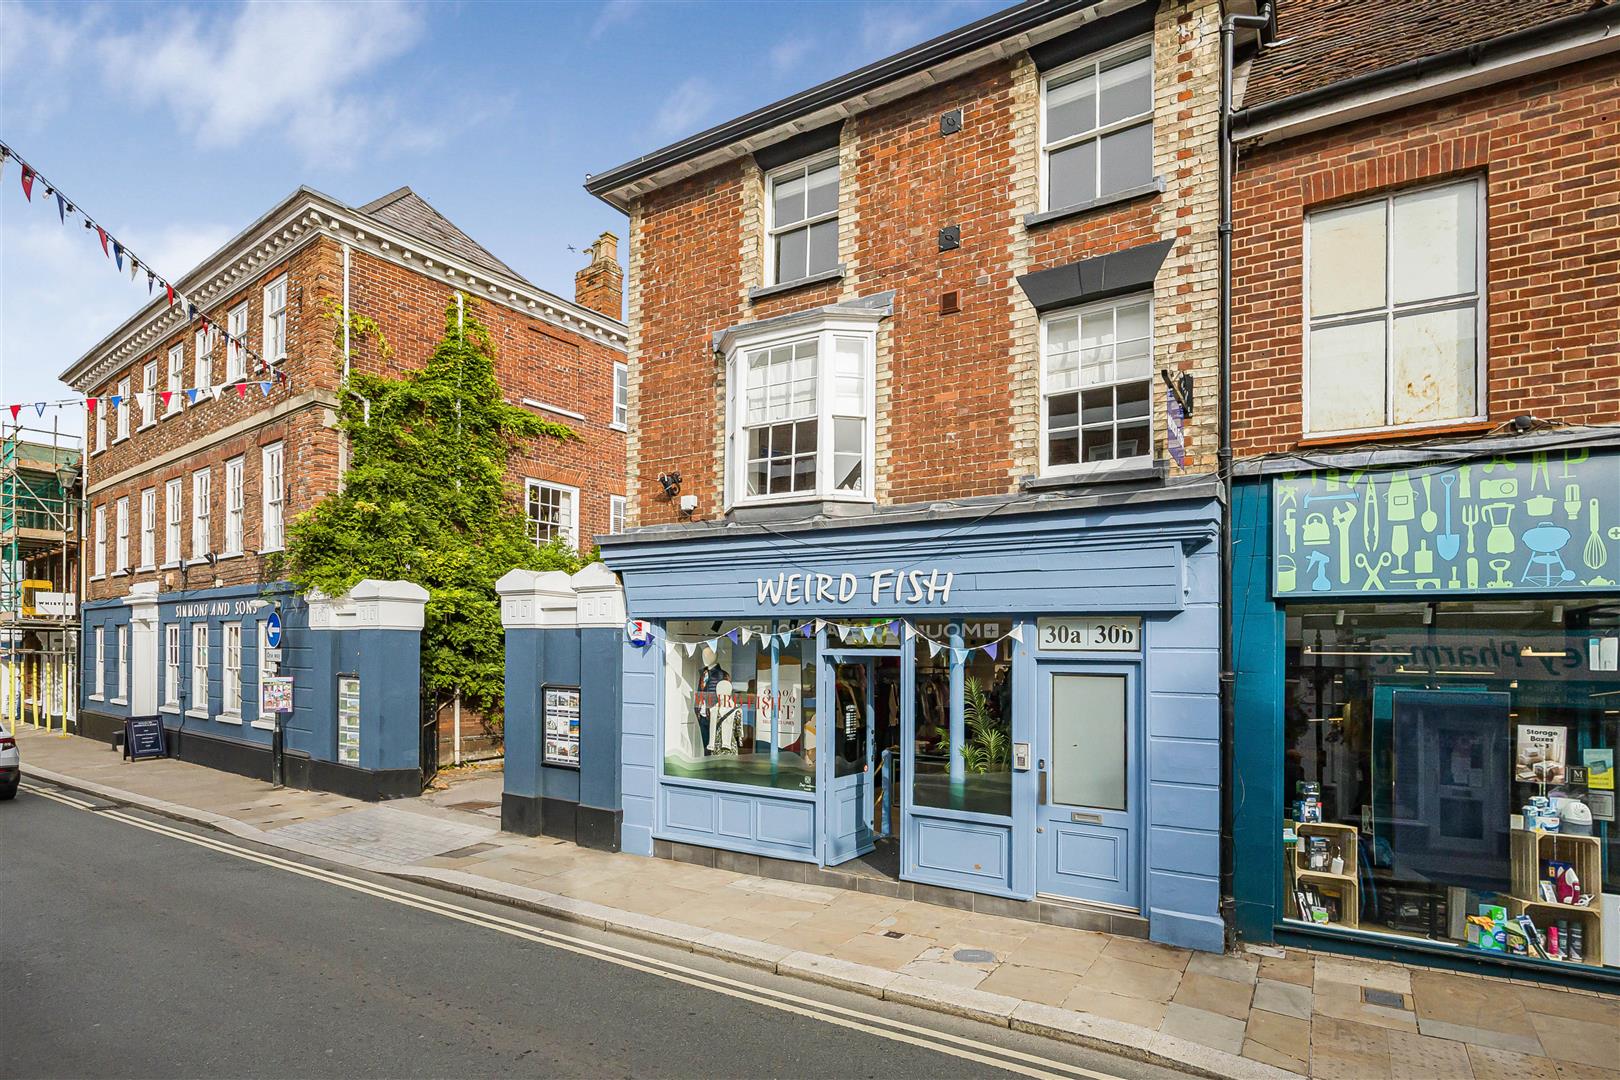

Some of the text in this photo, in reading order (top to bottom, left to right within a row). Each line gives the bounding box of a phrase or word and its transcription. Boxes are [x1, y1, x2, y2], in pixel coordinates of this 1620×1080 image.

[757, 568, 954, 605] WEIRD FISH
[175, 601, 257, 618] SIMMONS AND SONS
[1045, 625, 1134, 644] 30a 30b
[695, 691, 743, 708] WEIRD
[1526, 728, 1558, 737] Storage
